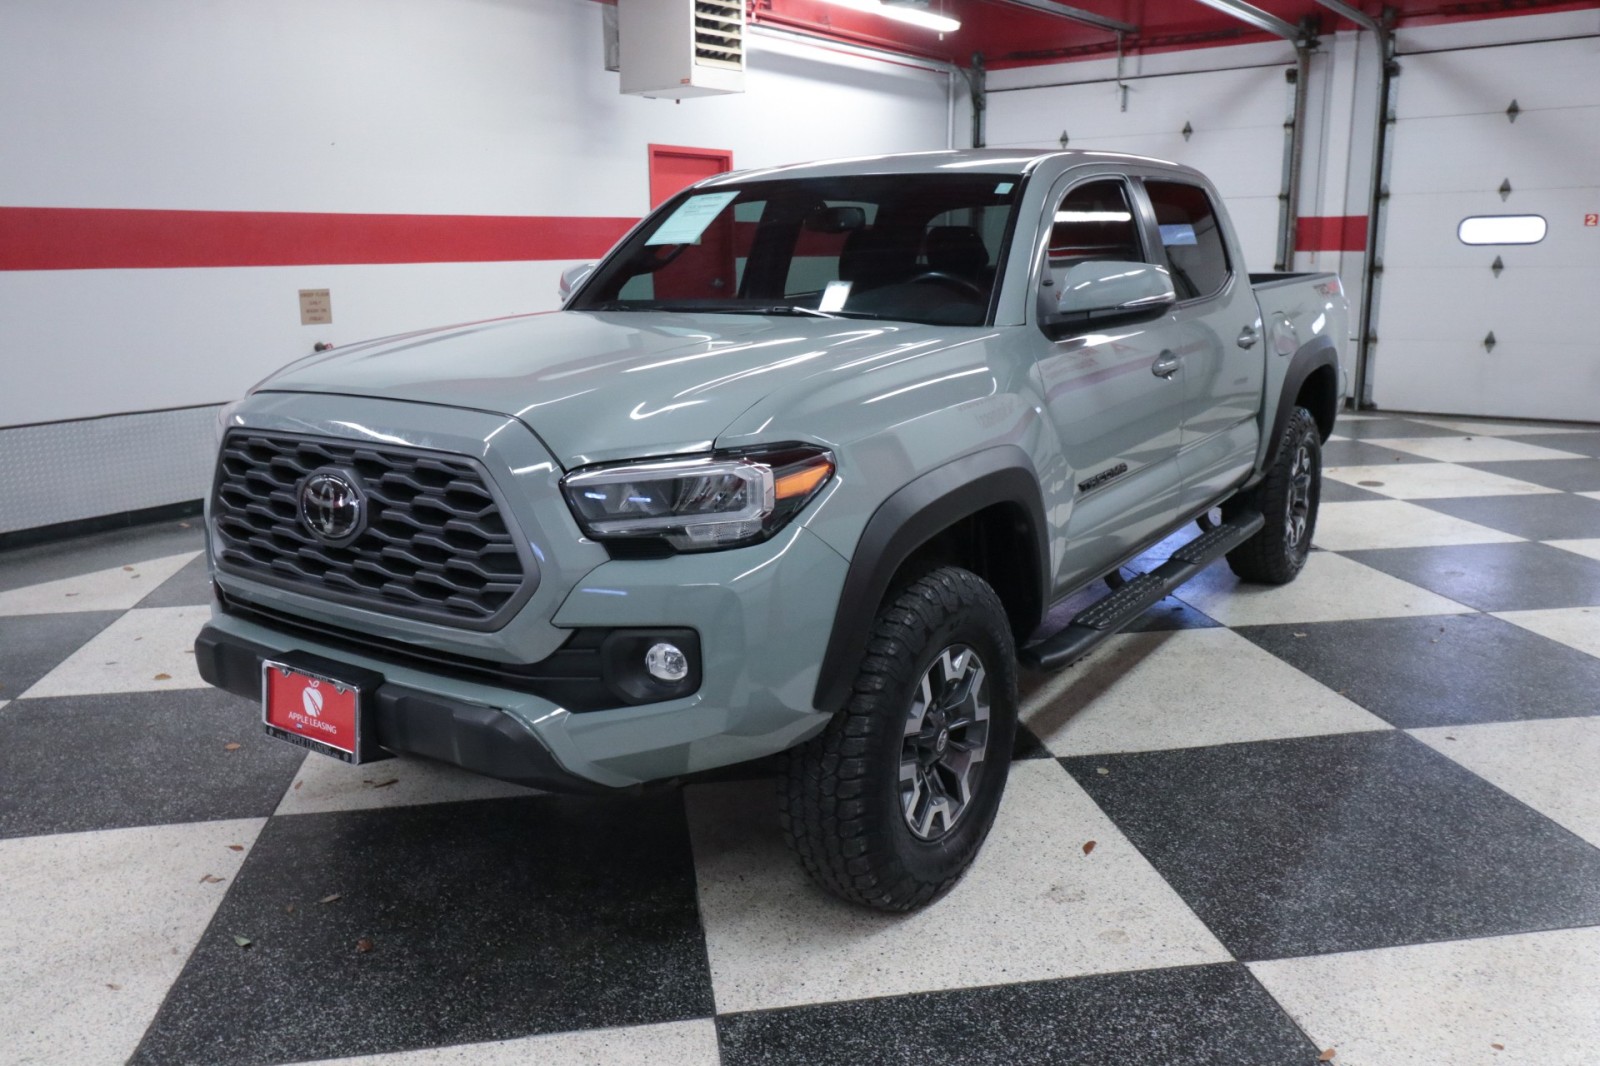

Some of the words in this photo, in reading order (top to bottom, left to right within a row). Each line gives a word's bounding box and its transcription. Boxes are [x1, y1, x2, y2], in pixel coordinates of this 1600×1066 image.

[1586, 214, 1597, 226] 2
[1078, 462, 1128, 492] TACOMA
[288, 711, 309, 725] APPLE
[309, 717, 337, 735] LEASING
